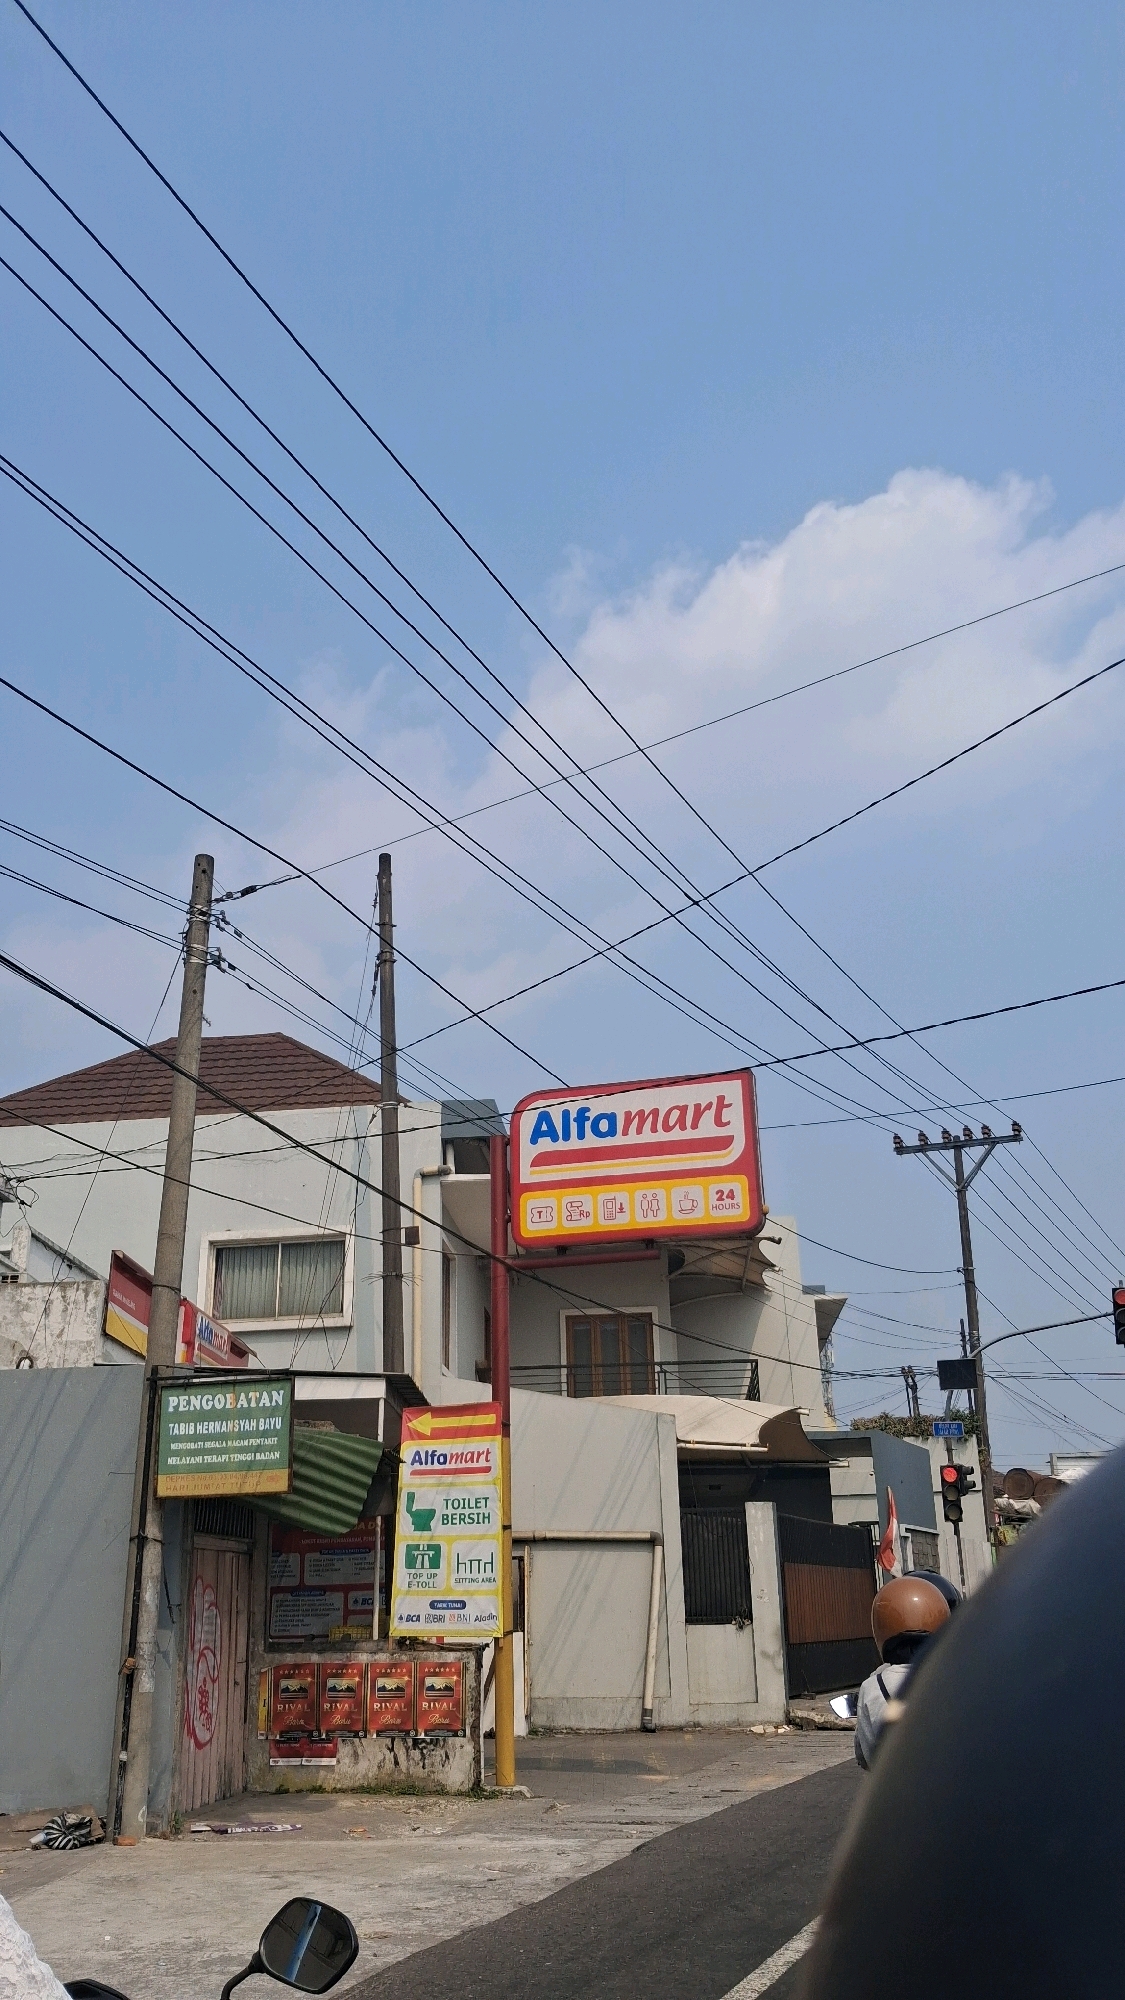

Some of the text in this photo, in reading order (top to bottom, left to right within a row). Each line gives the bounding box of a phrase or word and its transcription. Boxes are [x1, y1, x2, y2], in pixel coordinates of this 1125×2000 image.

[529, 1094, 733, 1146] Alfamart
[715, 1188, 736, 1202] 24
[711, 1202, 741, 1211] HOURS
[579, 1209, 591, 1220] Rp
[168, 1390, 285, 1412] PENGOBATAN
[169, 1417, 282, 1435] TABIB HERMANSYAH BAYU
[170, 1442, 204, 1450] MENGOBATI
[249, 1437, 278, 1446] PENYAKIT
[168, 1451, 280, 1465] MELAYANI TERAPI TINGGI BADAN
[410, 1447, 492, 1467] Alfamart
[443, 1497, 490, 1511] TOILET
[441, 1511, 491, 1526] BERSIH
[407, 1572, 438, 1581] TOP UP
[481, 1576, 497, 1584] AREA
[407, 1580, 437, 1589] E-TOLL
[405, 1614, 421, 1623] BCA
[474, 1613, 498, 1623] Aladin
[277, 1702, 310, 1713] RIVAL
[323, 1702, 358, 1713] RIVAL
[373, 1702, 408, 1712] RIVAL
[421, 1701, 456, 1711] RIVAL
